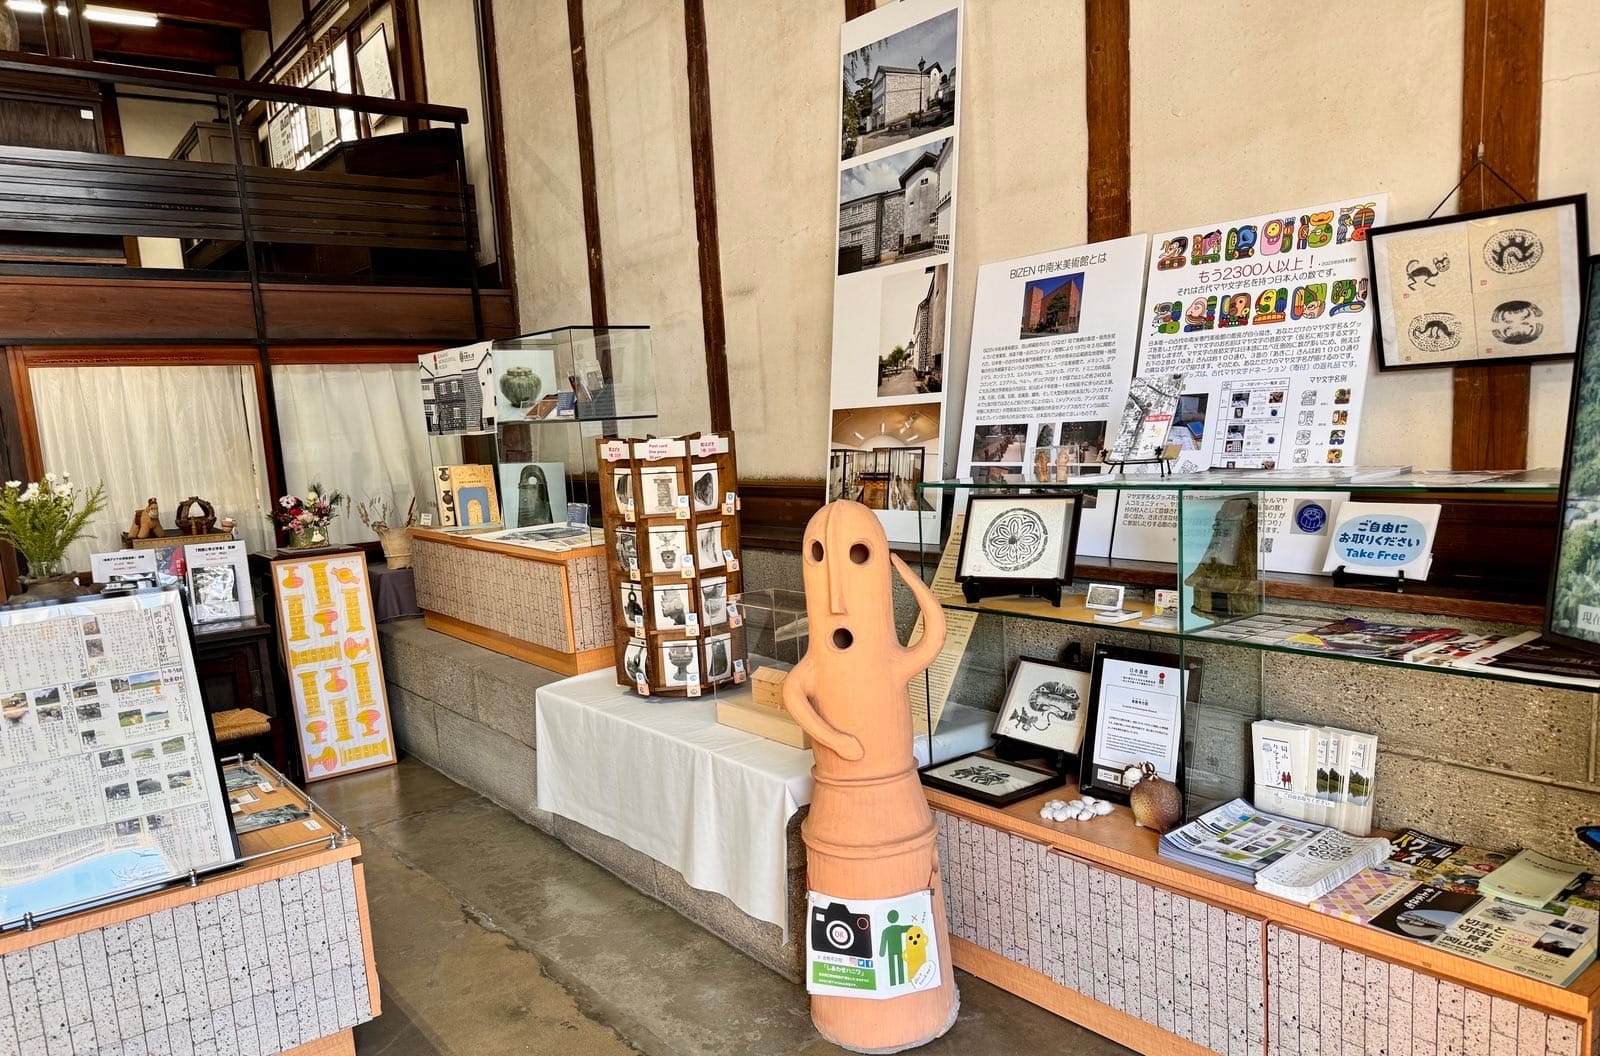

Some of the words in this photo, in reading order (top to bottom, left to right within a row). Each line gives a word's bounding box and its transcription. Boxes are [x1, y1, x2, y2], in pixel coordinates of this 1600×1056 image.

[1010, 266, 1036, 279] BIZEN
[1037, 253, 1107, 274] 中南米美術館とは
[1358, 520, 1408, 533] ご自由に
[1339, 532, 1420, 547] お取りください
[1346, 548, 1374, 559] Take
[1377, 550, 1406, 561] Free
[1465, 918, 1507, 935] 切手と
[1442, 935, 1491, 953] 岡山城
